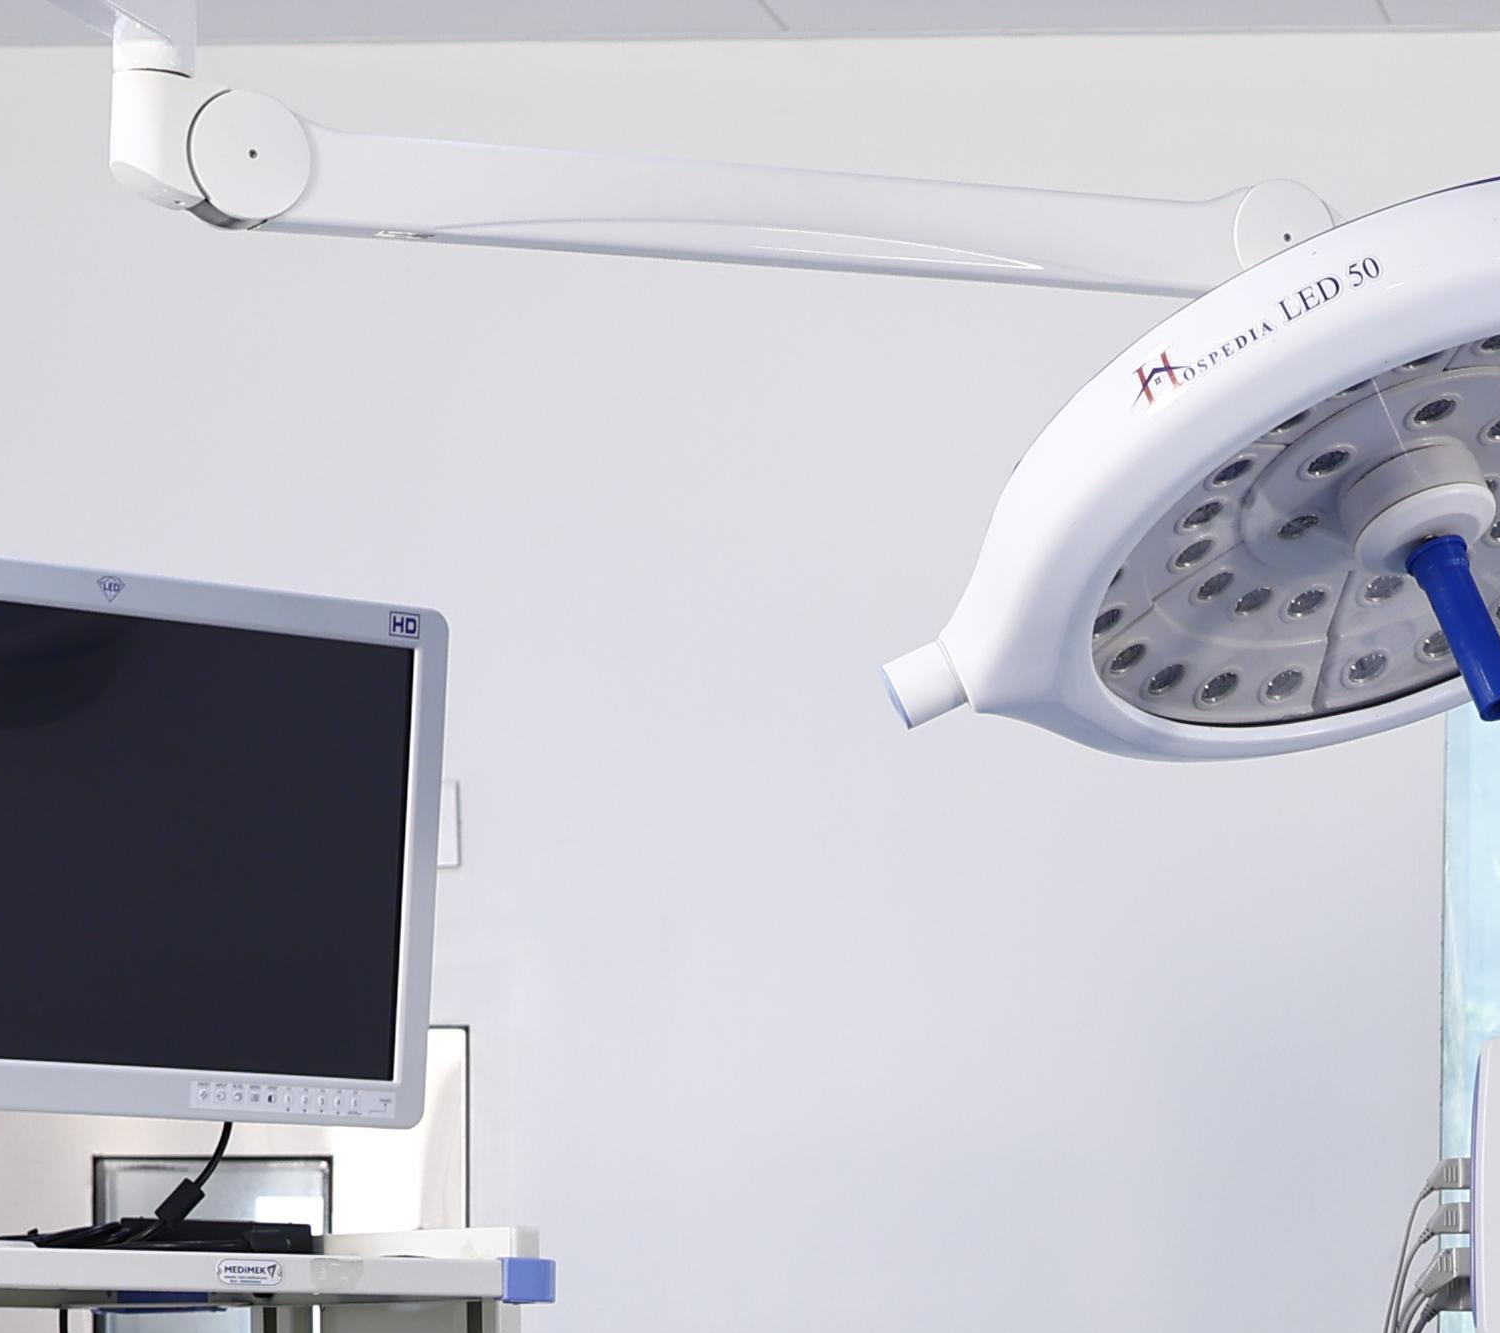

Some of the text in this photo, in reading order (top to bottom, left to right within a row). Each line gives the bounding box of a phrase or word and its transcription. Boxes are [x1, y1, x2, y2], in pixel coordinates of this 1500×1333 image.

[1278, 276, 1340, 321] LED
[1348, 257, 1380, 287] 50
[392, 615, 417, 634] HD
